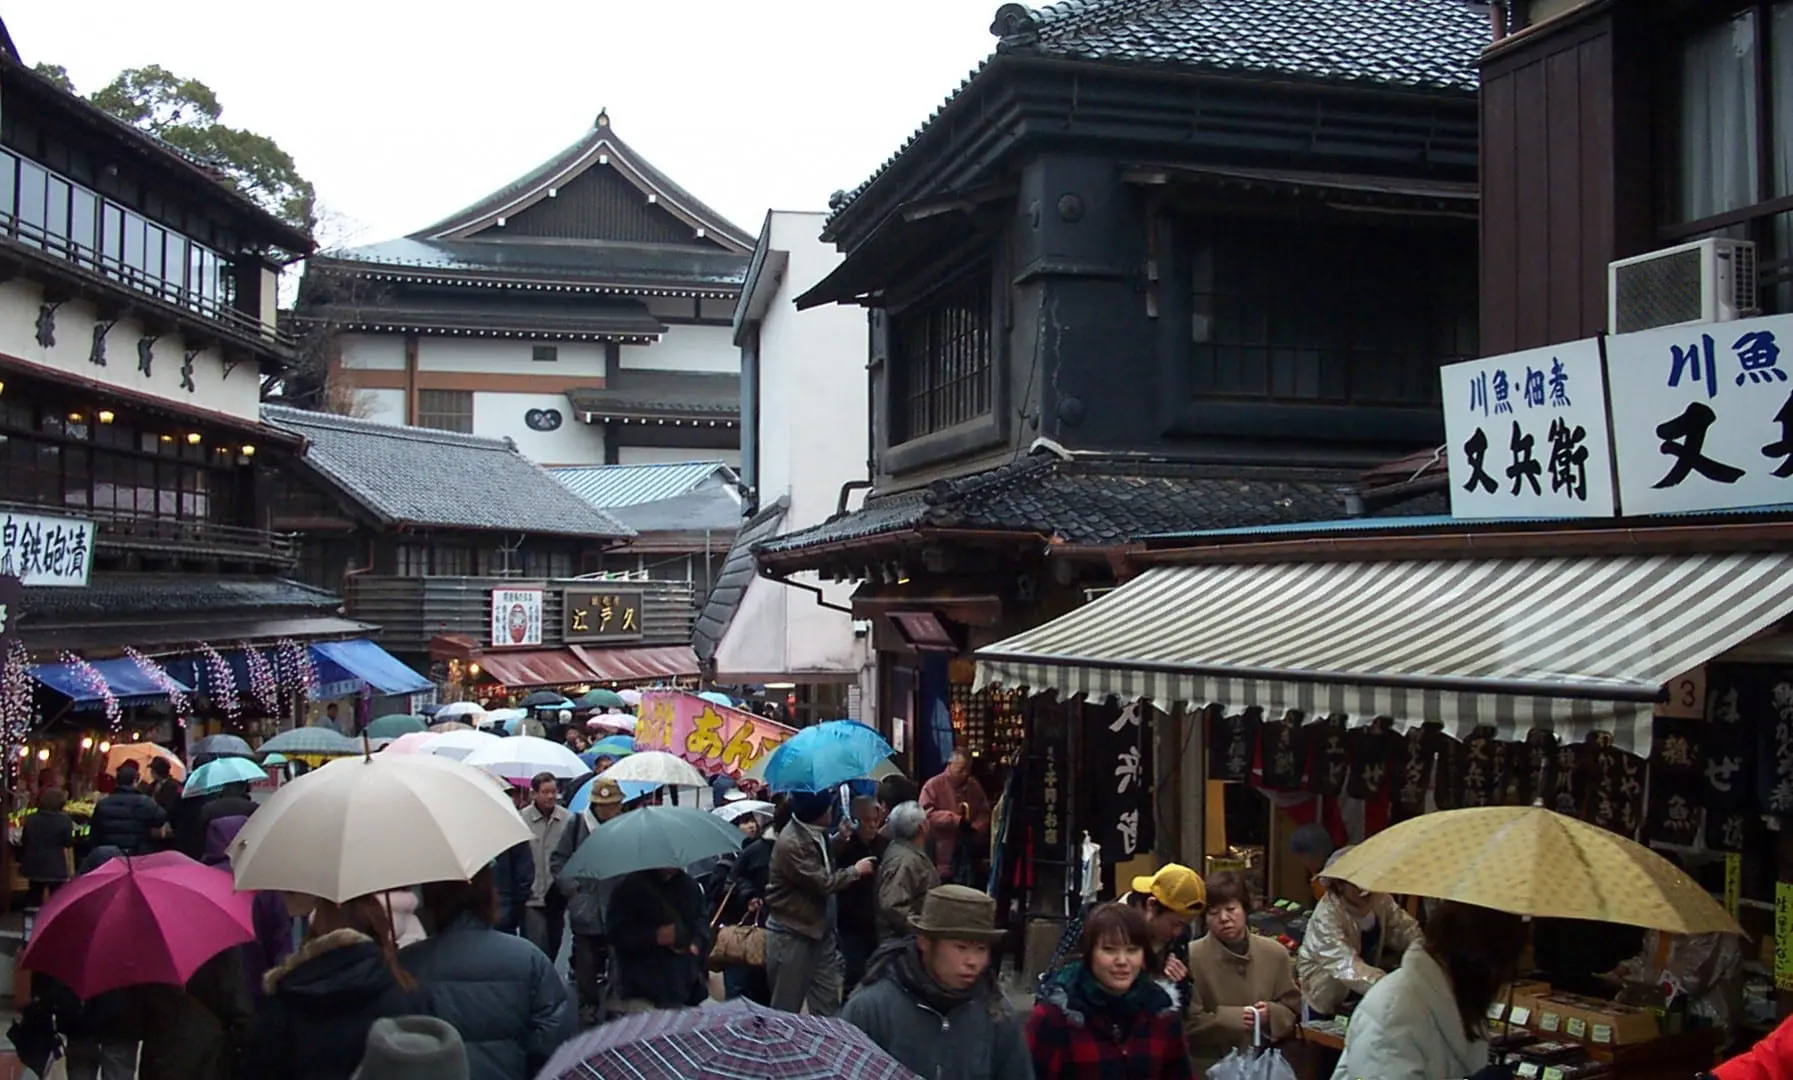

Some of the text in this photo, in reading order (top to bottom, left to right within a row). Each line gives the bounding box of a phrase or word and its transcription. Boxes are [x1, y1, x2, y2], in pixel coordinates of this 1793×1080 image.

[1469, 356, 1572, 418] 川魚・佃煮
[1667, 331, 1788, 399] 川魚
[1462, 417, 1588, 502] 又兵衛
[572, 606, 638, 633] 江戸久
